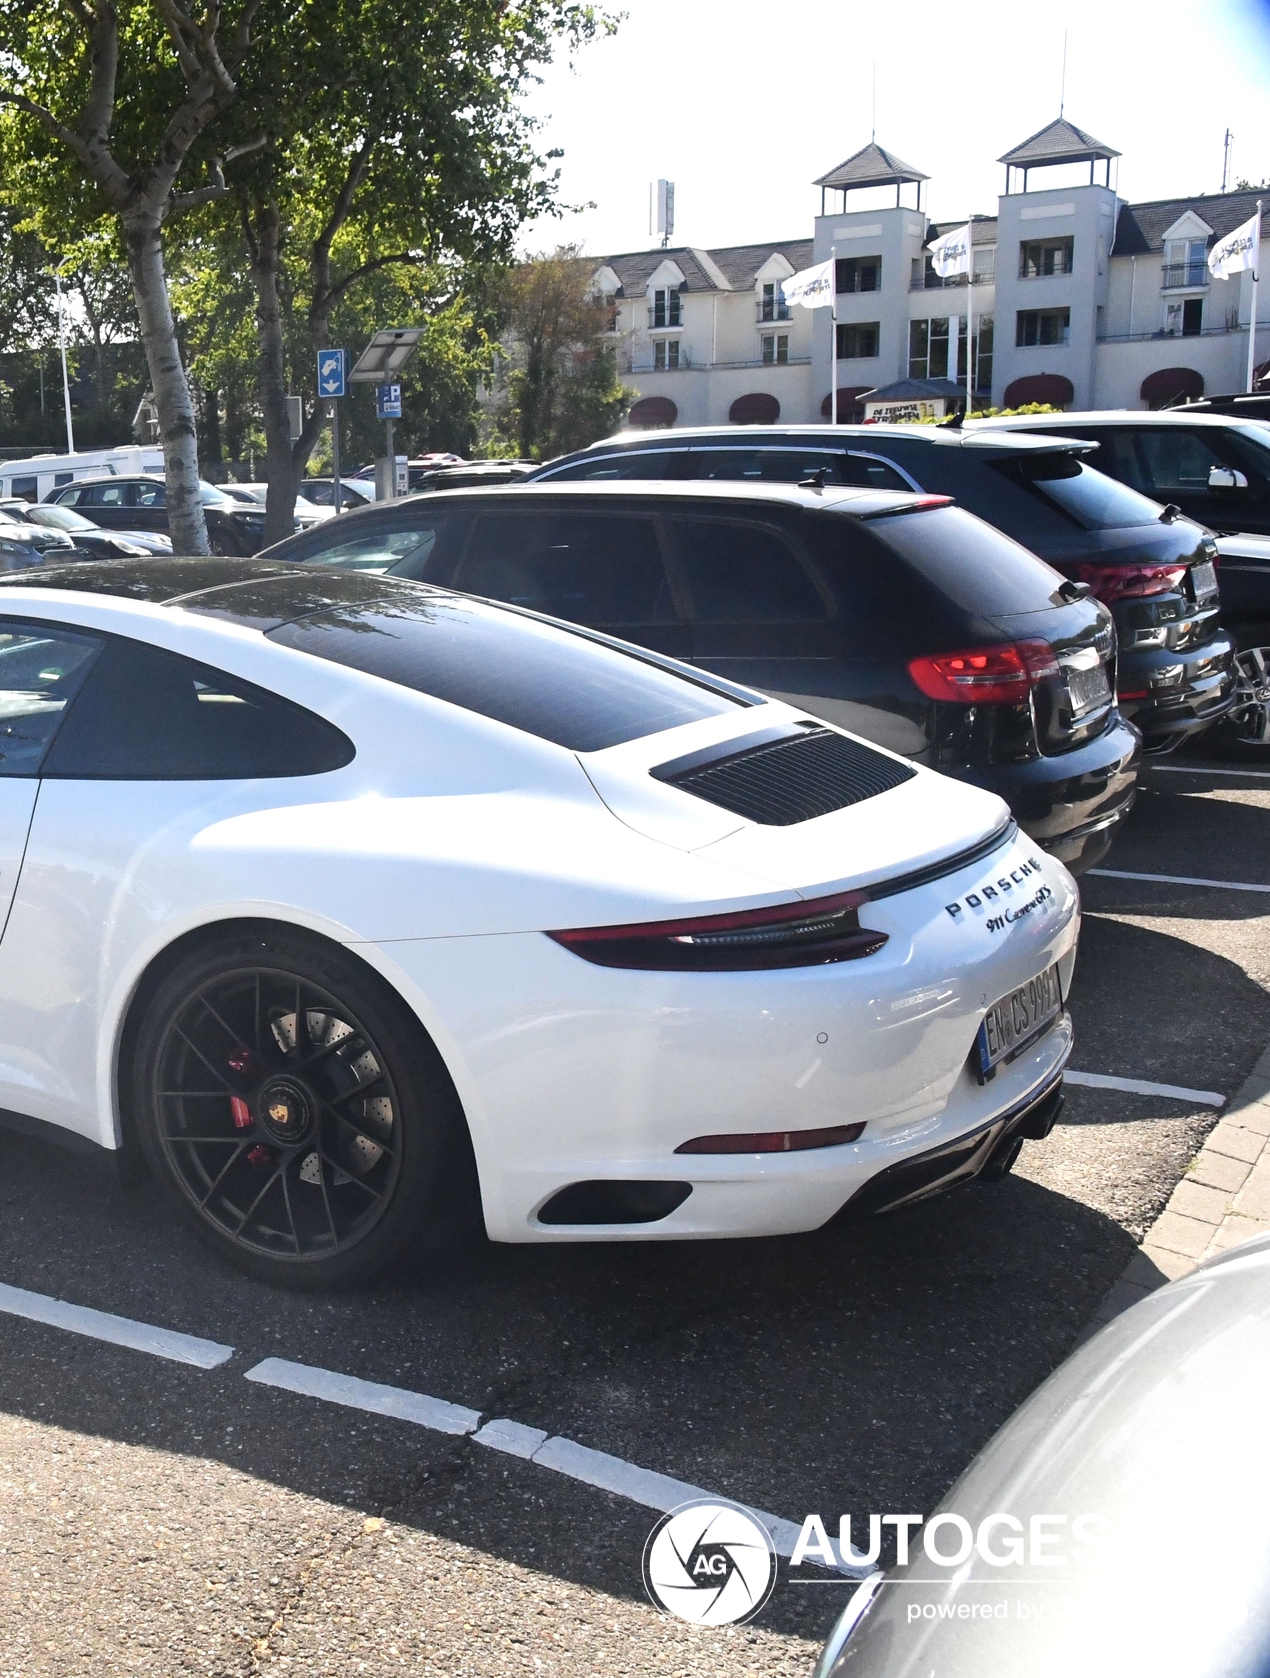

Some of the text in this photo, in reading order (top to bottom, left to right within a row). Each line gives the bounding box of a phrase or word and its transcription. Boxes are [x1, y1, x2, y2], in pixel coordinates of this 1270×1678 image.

[390, 385, 400, 401] P
[873, 408, 883, 416] DE
[945, 857, 1042, 918] PORSCHE
[986, 914, 1005, 933] 911
[986, 1006, 1006, 1058] EN
[1011, 987, 1029, 1035] CS
